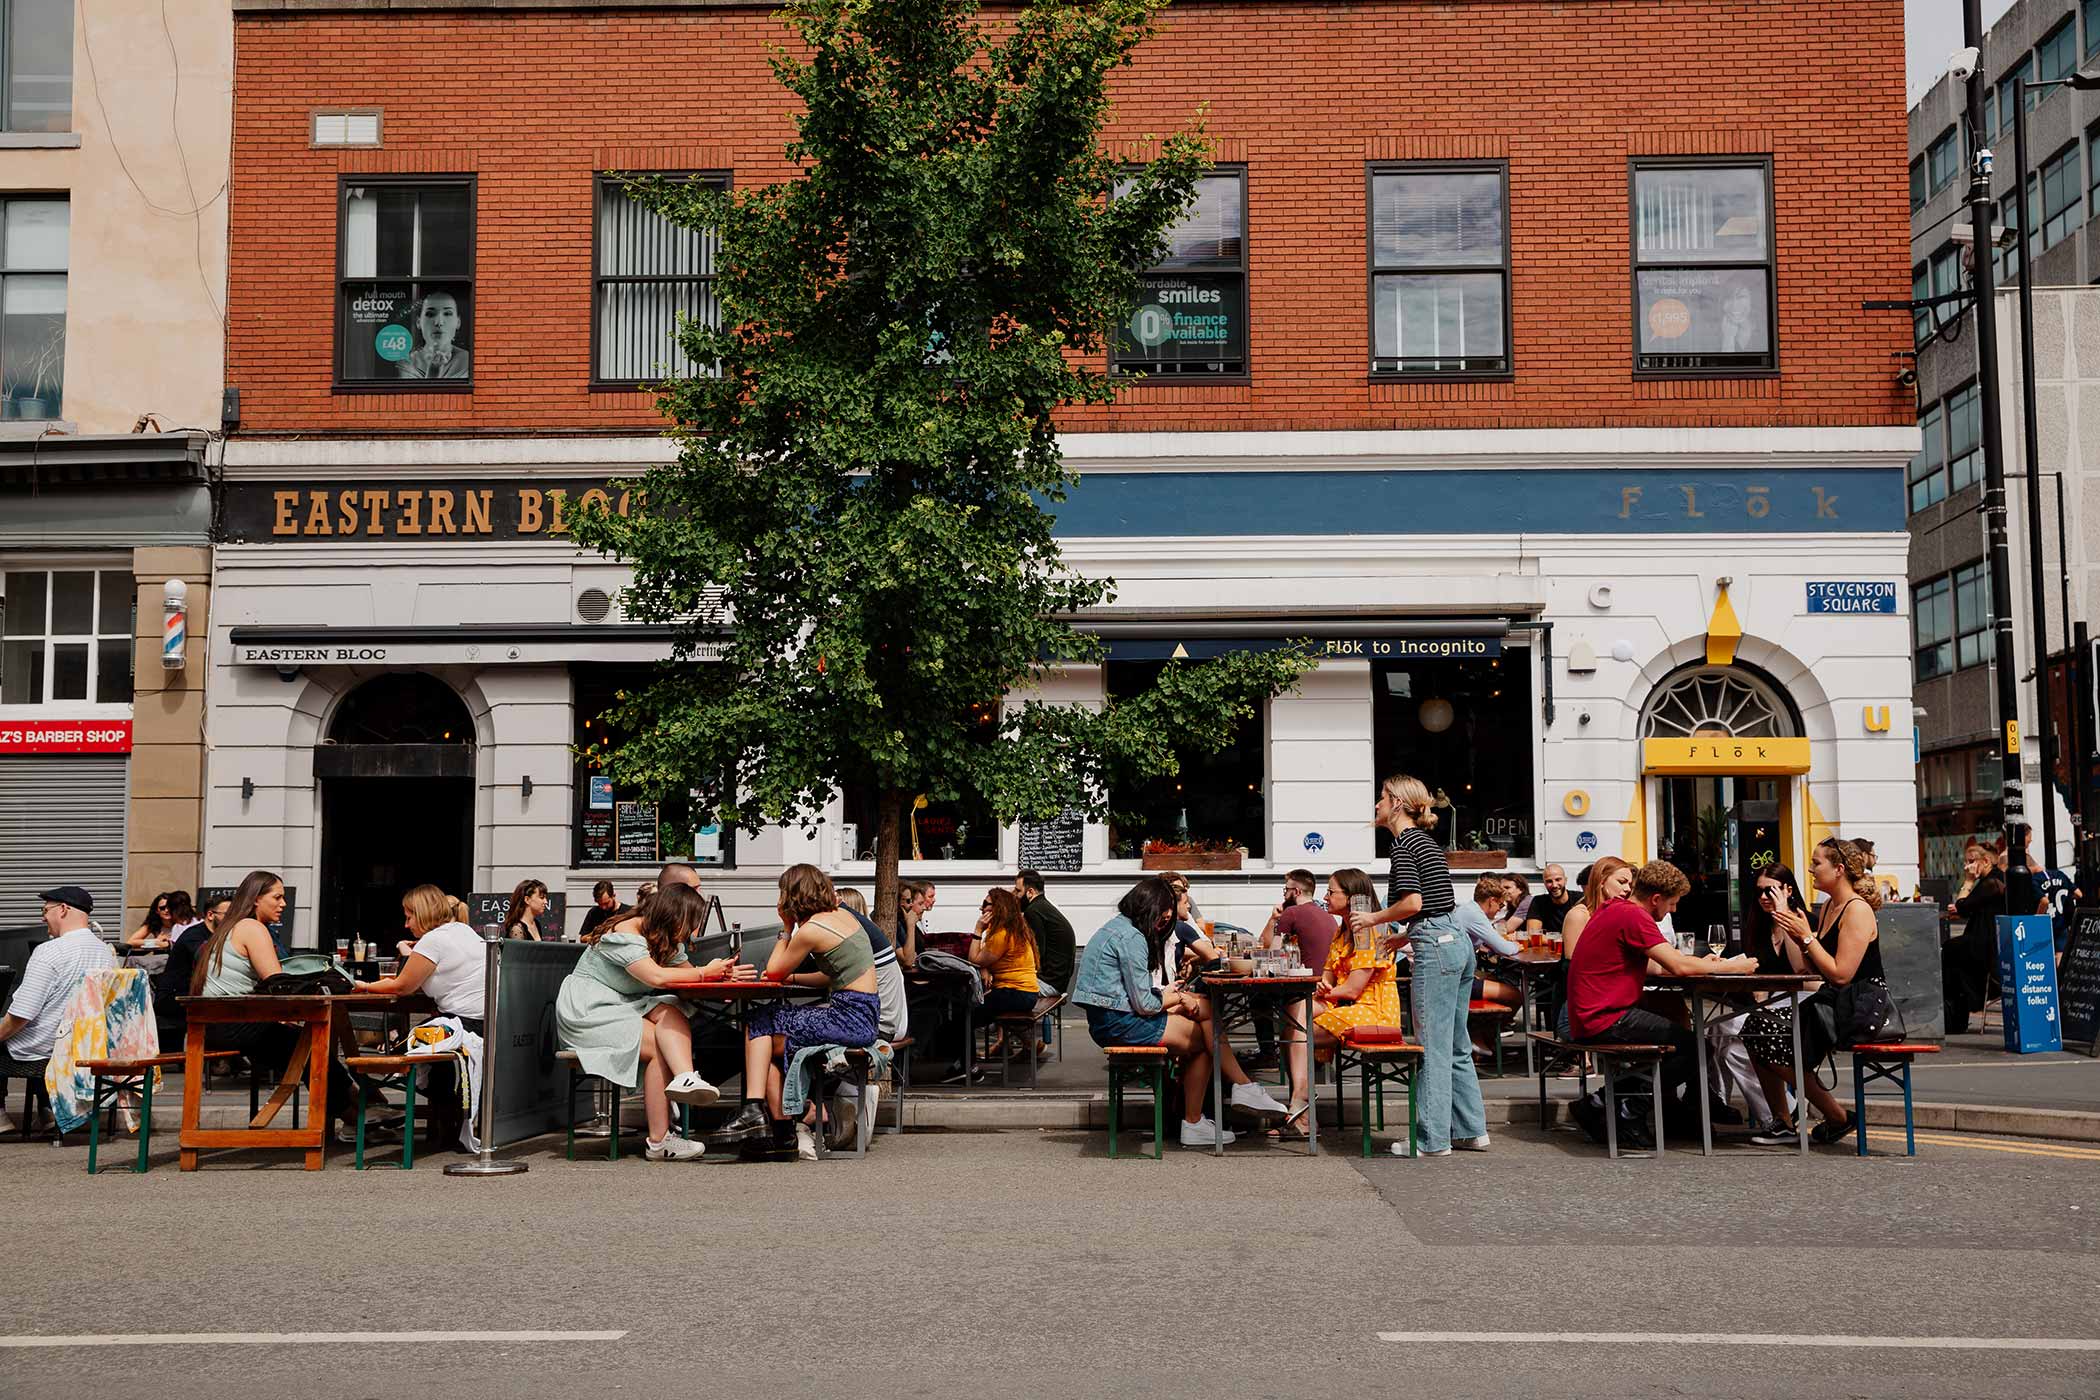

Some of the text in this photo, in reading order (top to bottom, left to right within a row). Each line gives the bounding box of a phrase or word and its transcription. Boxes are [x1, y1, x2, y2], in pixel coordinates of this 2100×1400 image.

[379, 290, 406, 299] mouth
[1158, 285, 1221, 303] smiles
[352, 297, 394, 311] detox
[1173, 312, 1228, 326] finance
[1164, 325, 1228, 340] available
[382, 336, 406, 351] £48
[272, 489, 494, 536] EASTERN
[1807, 583, 1895, 597] STEVENSON
[1822, 599, 1881, 612] SQUARE
[1373, 641, 1391, 654] to
[1400, 639, 1486, 656] Incognito
[246, 648, 386, 661] EASTERN BLOC
[0, 730, 126, 743] Z'S BARBER SHOP
[1486, 818, 1528, 836] OPEN
[481, 899, 552, 912] EASN
[2025, 961, 2045, 972] Keep
[2027, 975, 2045, 985] your
[2021, 984, 2052, 994] distance
[2027, 995, 2048, 1006] folks!
